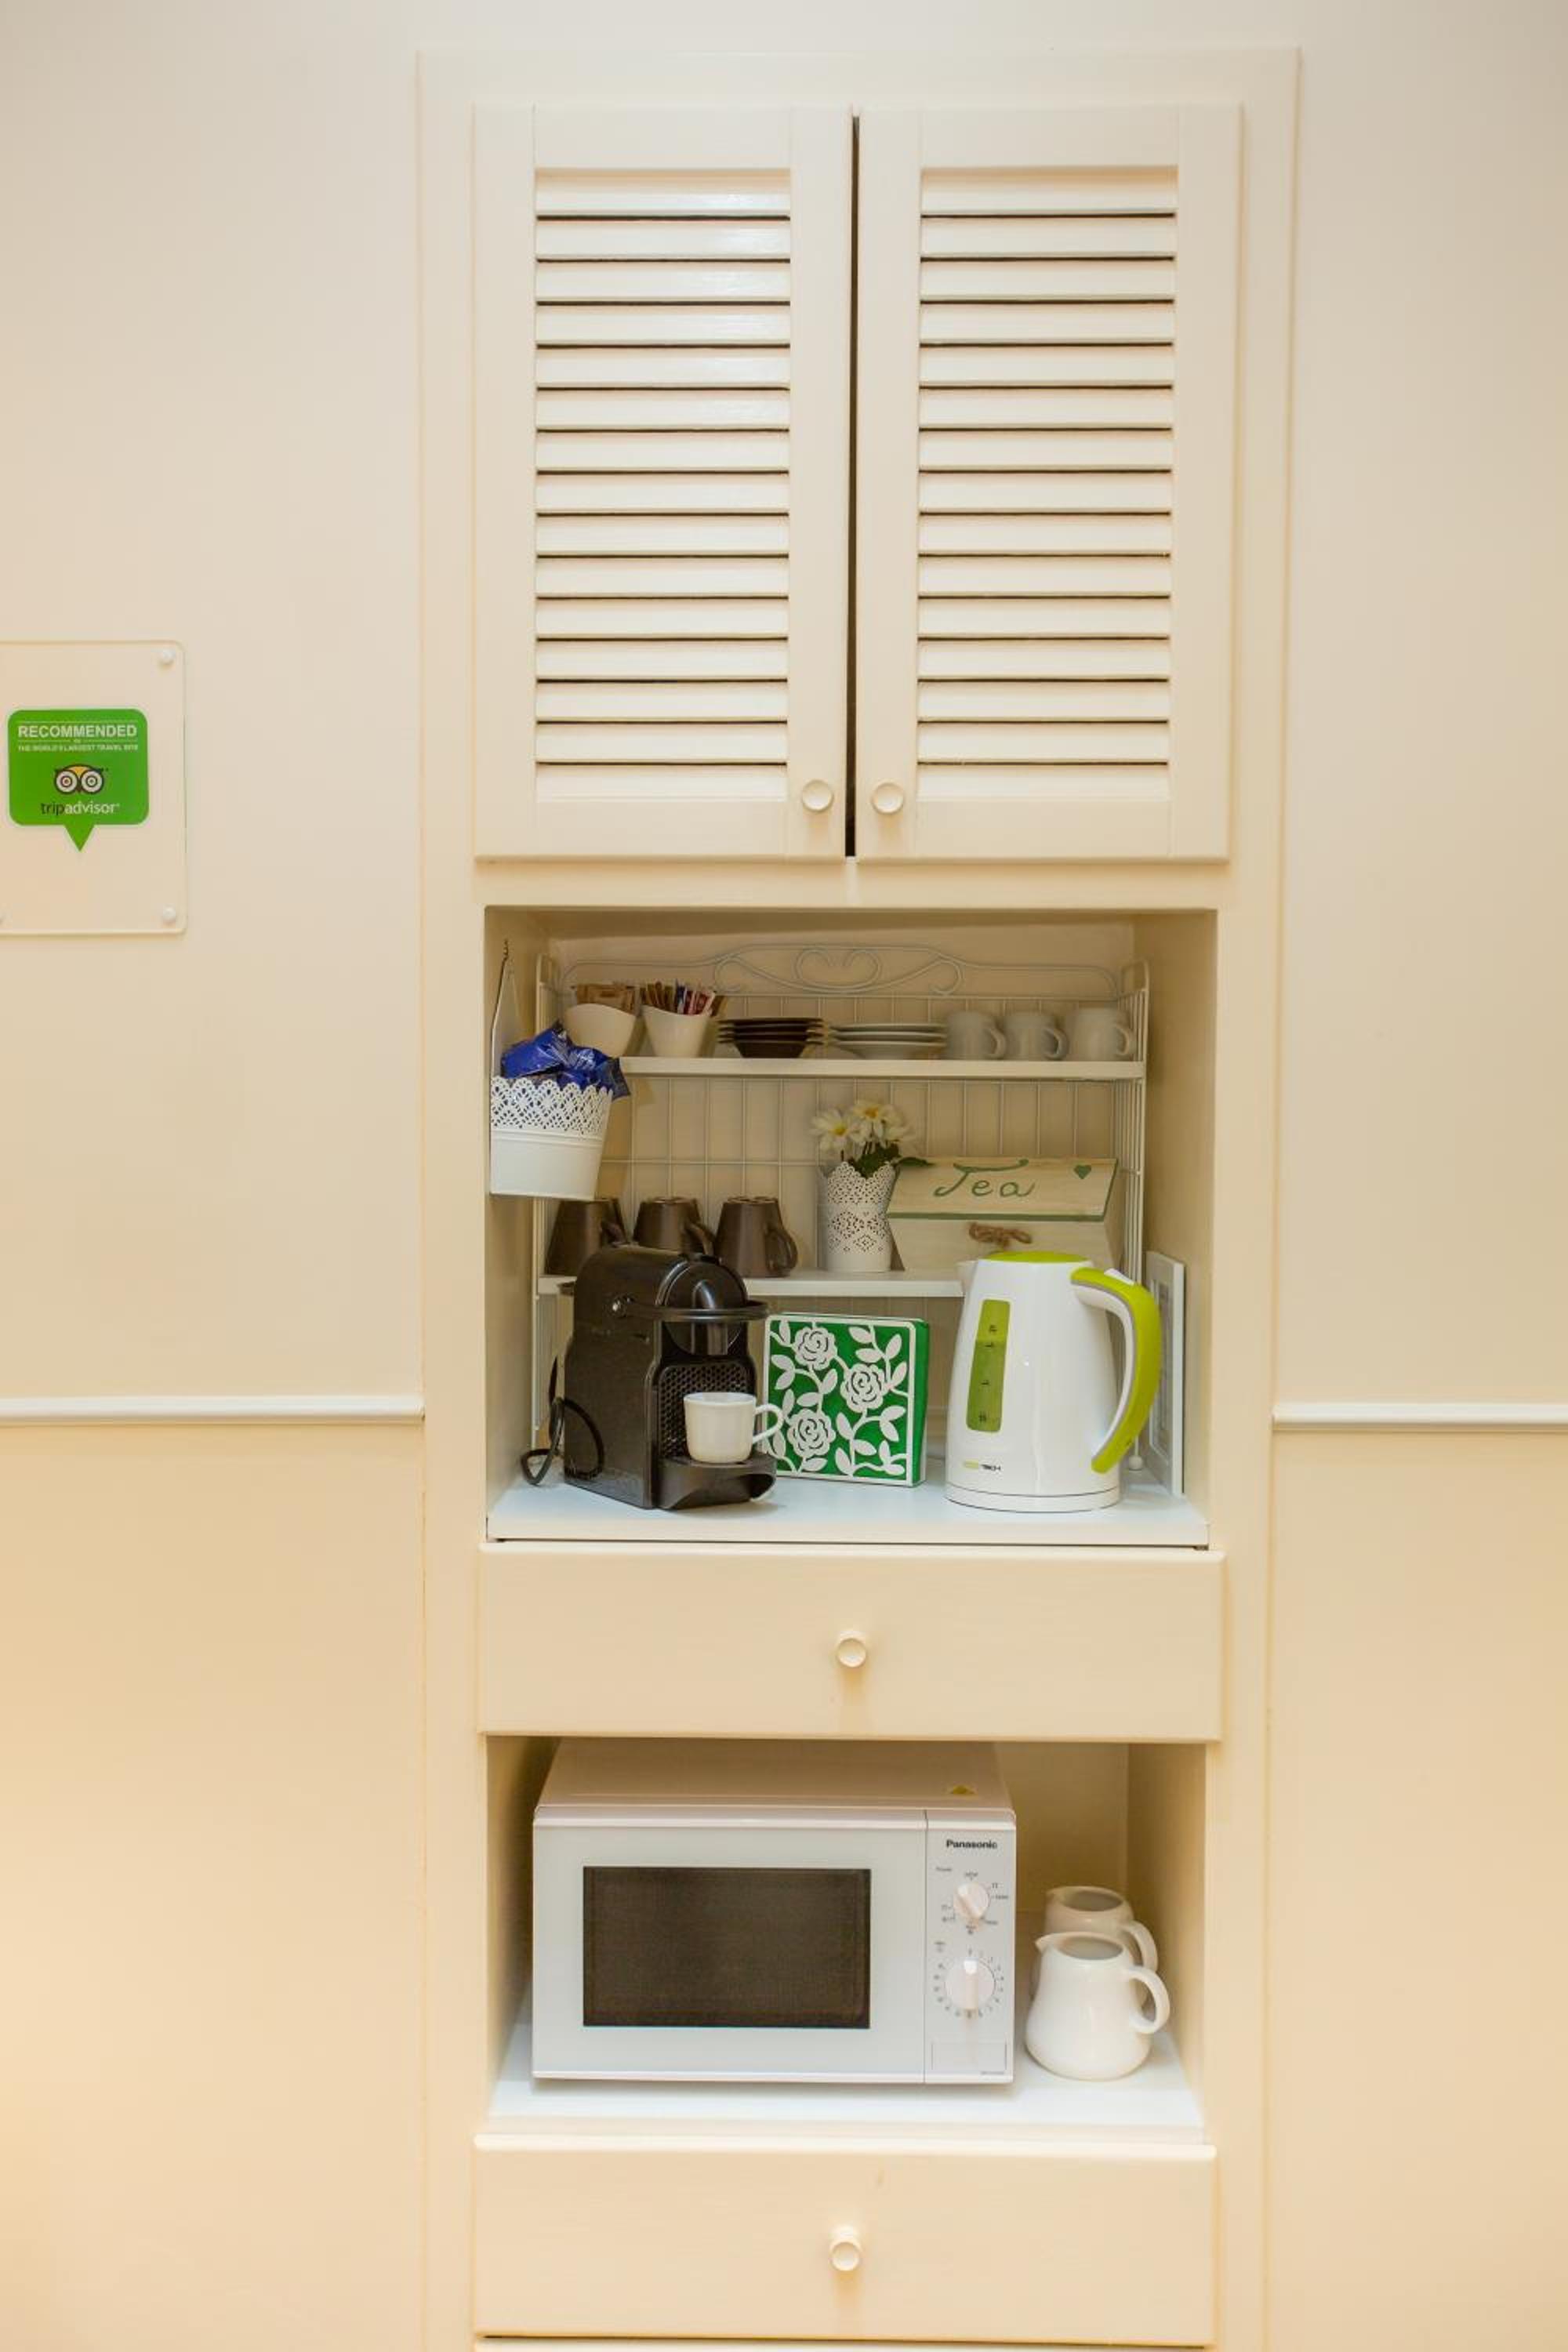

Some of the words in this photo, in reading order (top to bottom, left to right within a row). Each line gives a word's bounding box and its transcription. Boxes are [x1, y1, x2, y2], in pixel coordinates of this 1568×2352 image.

[18, 724, 137, 738] RECOMMENDED
[40, 800, 116, 816] tripadvisor
[933, 1158, 1036, 1198] Tea
[946, 1839, 998, 1849] Panasonic
